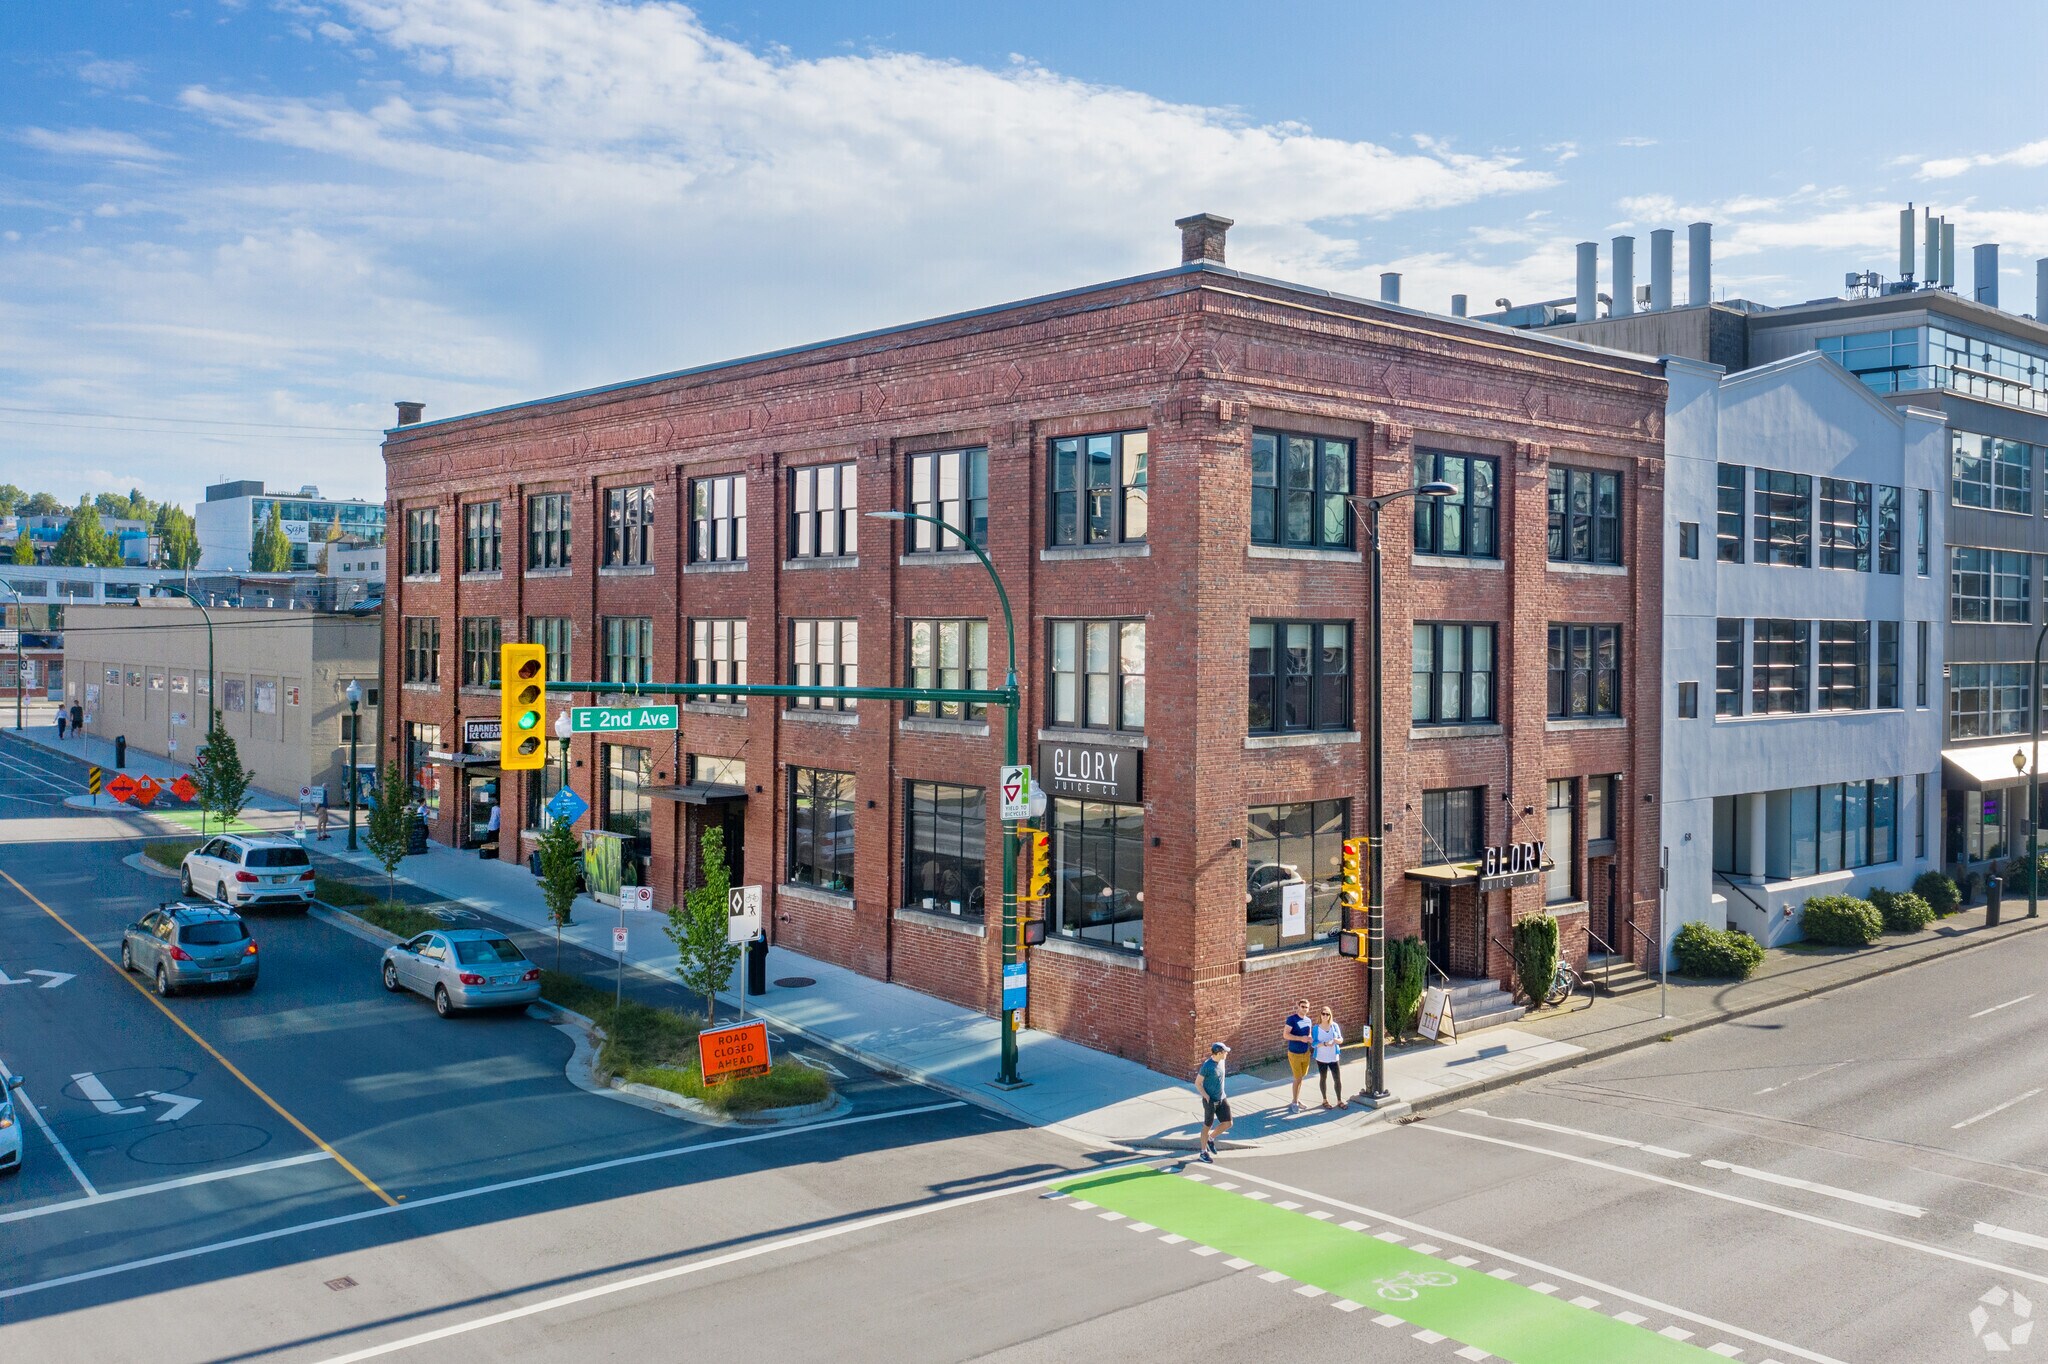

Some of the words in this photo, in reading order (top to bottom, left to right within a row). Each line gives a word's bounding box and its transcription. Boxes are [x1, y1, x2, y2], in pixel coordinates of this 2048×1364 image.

[285, 525, 306, 535] Saje
[580, 712, 591, 728] E
[600, 711, 632, 727] 2nd
[639, 710, 670, 726] Ave
[469, 724, 502, 732] EARNEST
[1054, 748, 1118, 781] GLORY
[1055, 780, 1090, 793] JUICE
[1102, 785, 1119, 796] CO.
[1684, 832, 1692, 841] 68
[1486, 841, 1546, 876] GLORY
[1480, 876, 1514, 891] JUICE
[718, 1032, 748, 1046] ROAD
[714, 1043, 755, 1058] CLOSED
[718, 1055, 754, 1070] AHEAD
